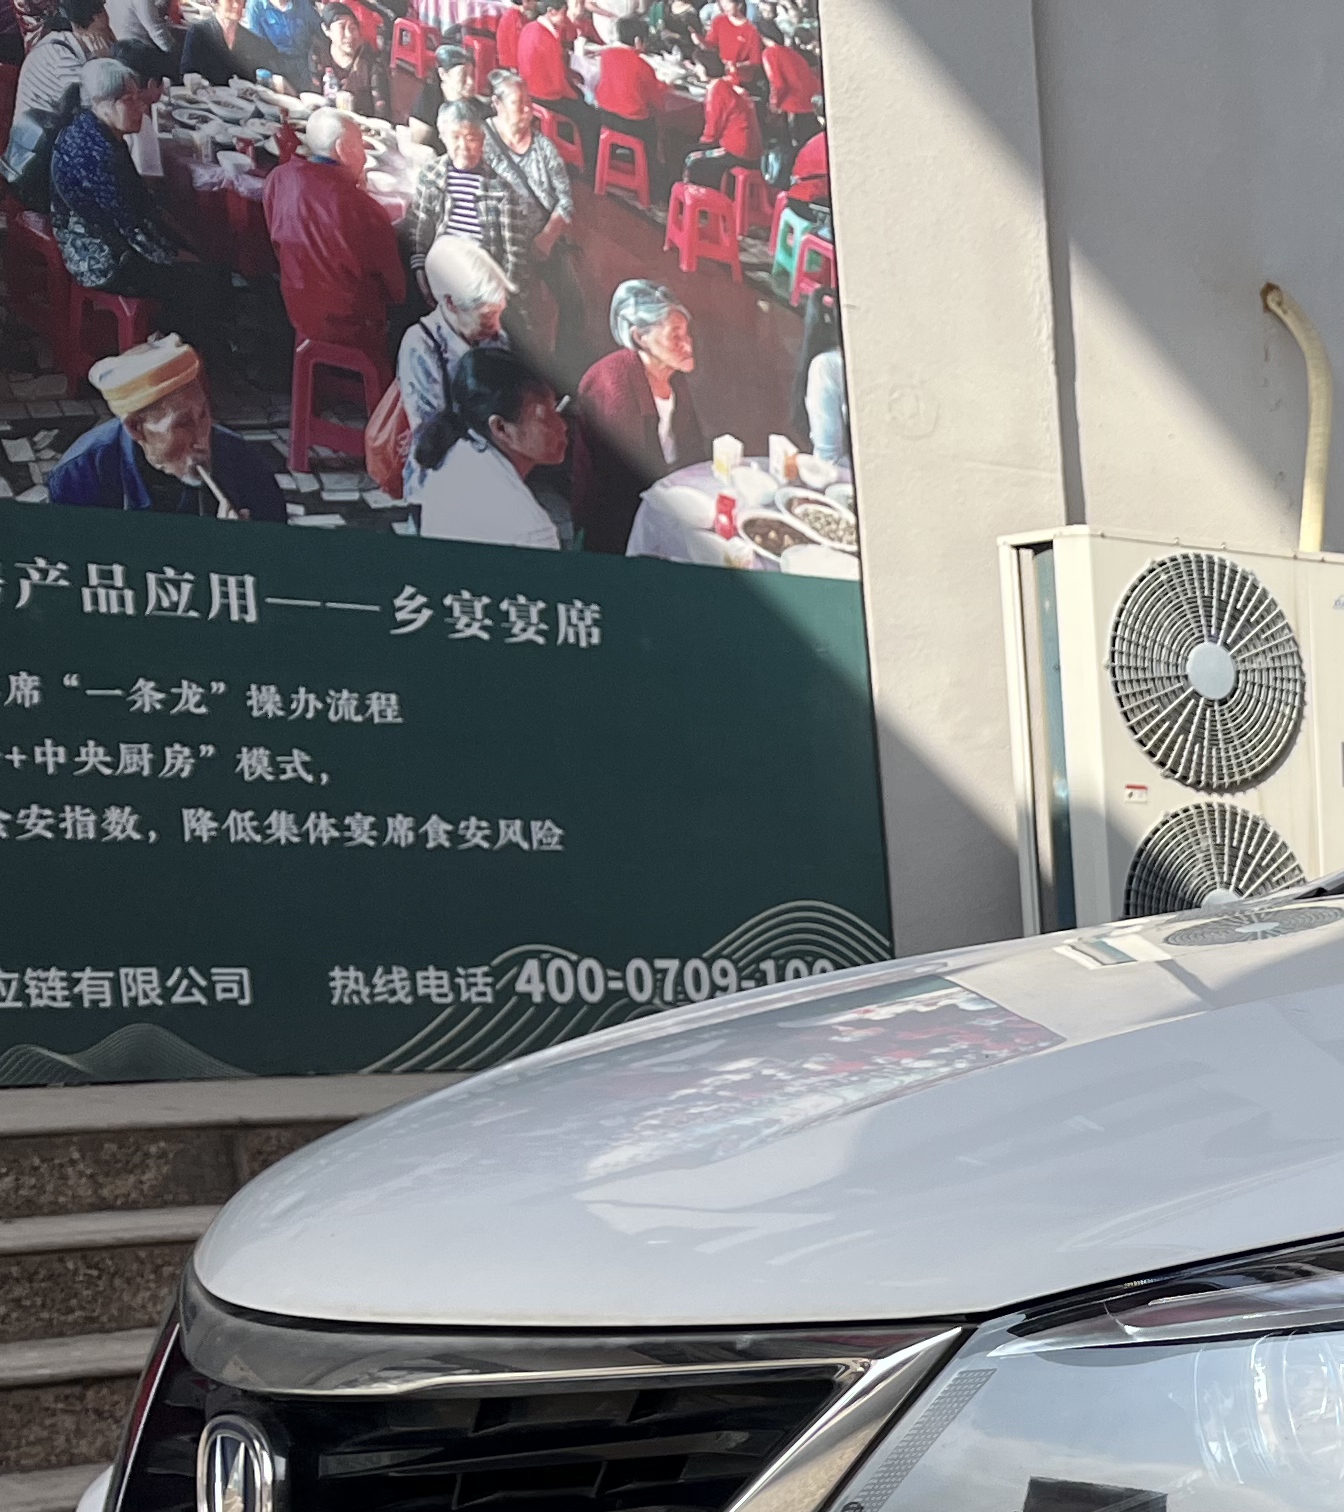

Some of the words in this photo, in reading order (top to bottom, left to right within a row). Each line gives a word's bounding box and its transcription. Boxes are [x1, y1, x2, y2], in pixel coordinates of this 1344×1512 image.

[0, 556, 603, 648] 产品应用——乡宴宴席
[328, 964, 494, 1005] 热线电话
